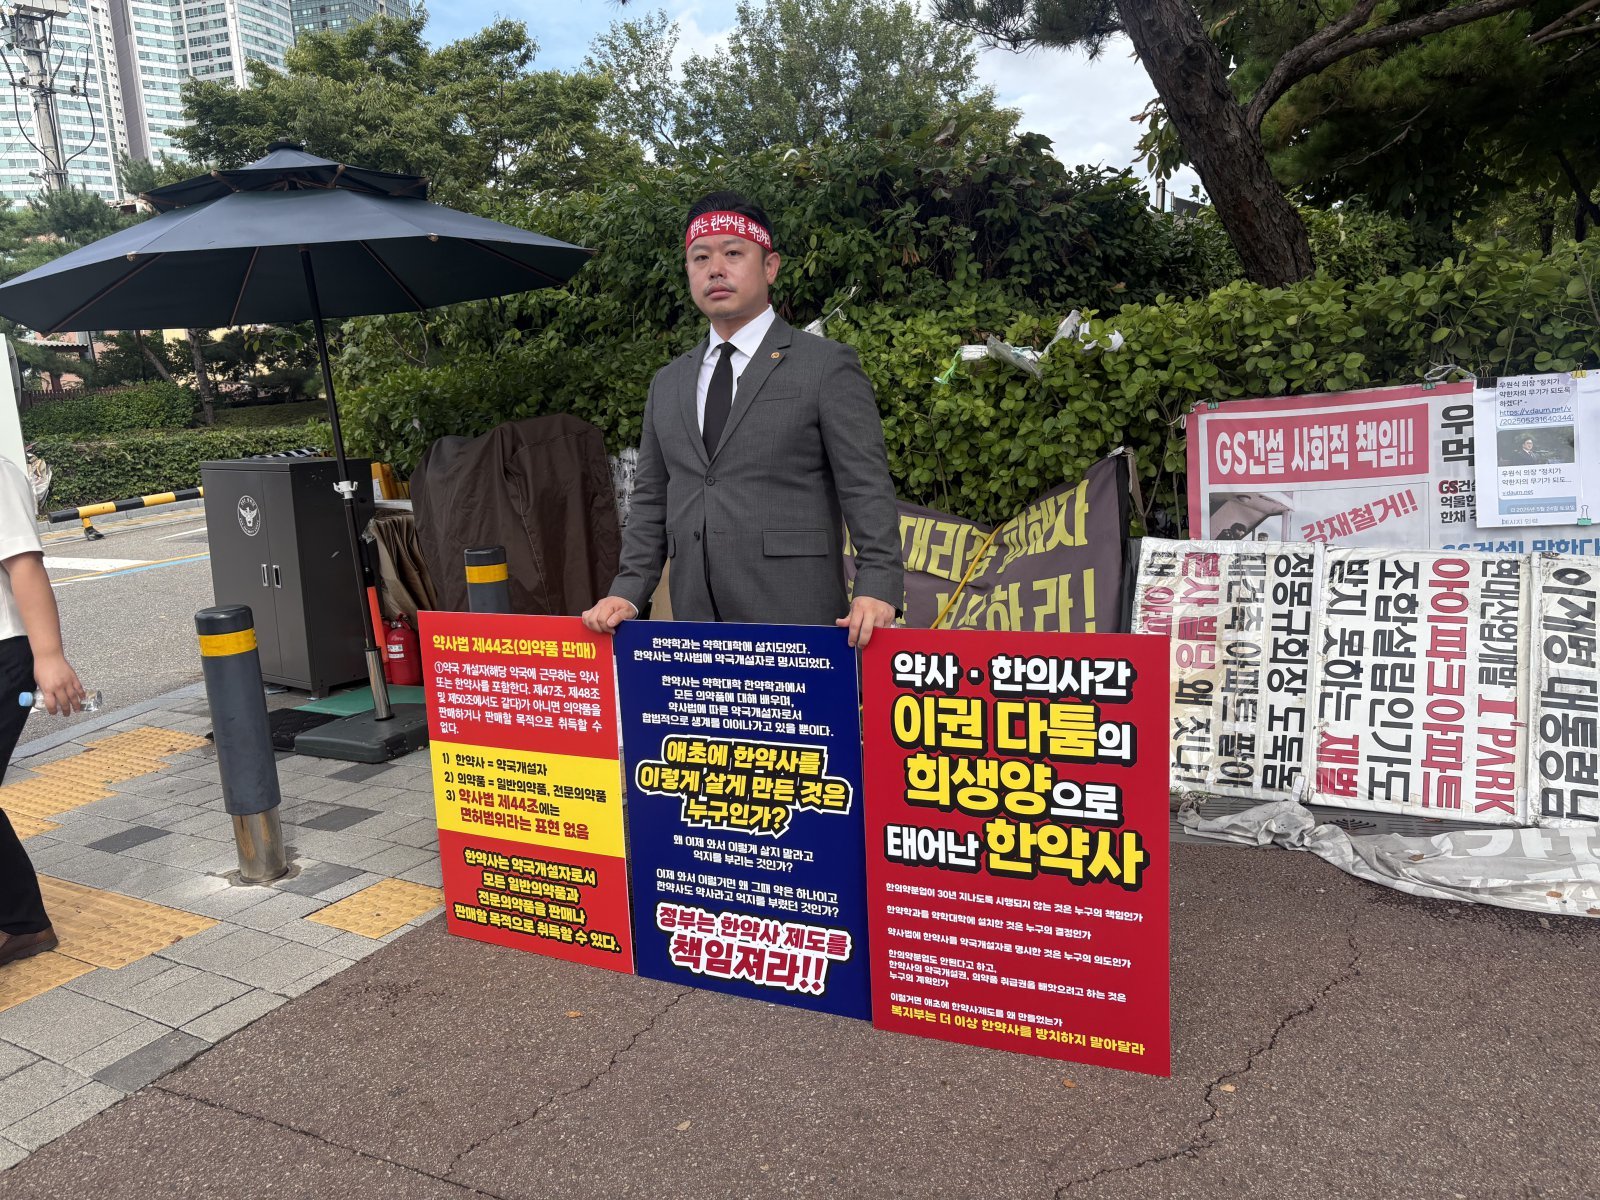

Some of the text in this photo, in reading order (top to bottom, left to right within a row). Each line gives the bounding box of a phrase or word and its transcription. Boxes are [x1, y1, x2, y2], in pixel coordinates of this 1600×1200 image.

[711, 215, 746, 234] 한약사를
[1215, 417, 1413, 476] GS건설 사회적 책임!!
[1441, 511, 1466, 523] 한채
[1180, 552, 1220, 607] 본사
[1267, 552, 1314, 693] 정몽규회장
[1477, 559, 1521, 687] 현대산업개발
[1543, 567, 1597, 668] 이재명
[433, 635, 596, 659] 약사법 제44조(의약품 판매)
[652, 638, 810, 654] 한약학과는 약학대학에 설치되었다.
[1176, 615, 1217, 669] 빌딩
[462, 664, 507, 679] 개설자(해당
[510, 666, 536, 679] 약국에
[539, 668, 576, 682] 근무하는
[580, 670, 599, 684] 약사
[894, 653, 1131, 696] 약사 한의사간
[1220, 642, 1262, 722] 아파트
[1316, 559, 1369, 798] 받지 못하는 재벌
[1367, 559, 1419, 802] 조합설립인가도
[1421, 558, 1471, 809] 아이파크아파트
[448, 693, 498, 708] 제50조에서도
[501, 697, 530, 711] 같다)가
[533, 699, 560, 713] 아니면
[564, 702, 601, 716] 의약품을
[669, 702, 802, 720] 약사법에 따른 약국개설자로서
[674, 689, 693, 700] 모든
[738, 693, 757, 704] 대해
[760, 694, 794, 707] 배우며,
[1175, 680, 1213, 706] 왜
[439, 707, 602, 733] 판매하거나 판매할 목적으로 취득할 수
[440, 722, 459, 734] 없다.
[894, 696, 1130, 760] 이권 다툼의
[442, 753, 547, 776] 1) 한약사 약국개설자
[667, 740, 820, 775] 애초에 한약사를
[1540, 676, 1599, 822] 대통령님
[445, 772, 606, 803] 2) 의약품 일반의약품, 전문의약품
[446, 789, 560, 817] 3) 약사법 제44조에는
[641, 766, 845, 808] 이렇게 살게 만든 것은
[907, 753, 1118, 820] 희생양으로
[461, 807, 589, 840] 면허범위라는 표현 없음
[687, 798, 788, 829] 누구인가?
[465, 849, 596, 885] 한약사는 약국개설자로서
[694, 849, 792, 873] 억지를 부리는 것인가?
[886, 818, 1143, 884] 태어난 한약사
[483, 872, 579, 902] 모든 일반의약품과
[657, 868, 674, 880] 이제
[677, 870, 695, 882] 와서
[739, 879, 748, 891] 왜
[751, 881, 770, 894] 그때
[774, 884, 793, 897] 약은
[797, 887, 837, 904] 하나이고
[886, 883, 1143, 922] 한의약분업이 30년 지나도록 시행되지 않는 것은 누구의 책임인가
[478, 890, 585, 924] 전문의약품을 판매나
[455, 904, 621, 952] 판매할 목적으로 취득할 수 있다.
[659, 906, 848, 957] 정부는 한약사 제도를
[672, 933, 824, 991] 책임져라!!
[891, 1004, 1145, 1055] 복지부는 더 이상 한약사를 방치하지 말아달라
[924, 997, 949, 1010] 애초에
[952, 1001, 1004, 1018] 한약사제도를
[1007, 1010, 1015, 1020] 왜
[1019, 1012, 1063, 1027] 만들었는가
